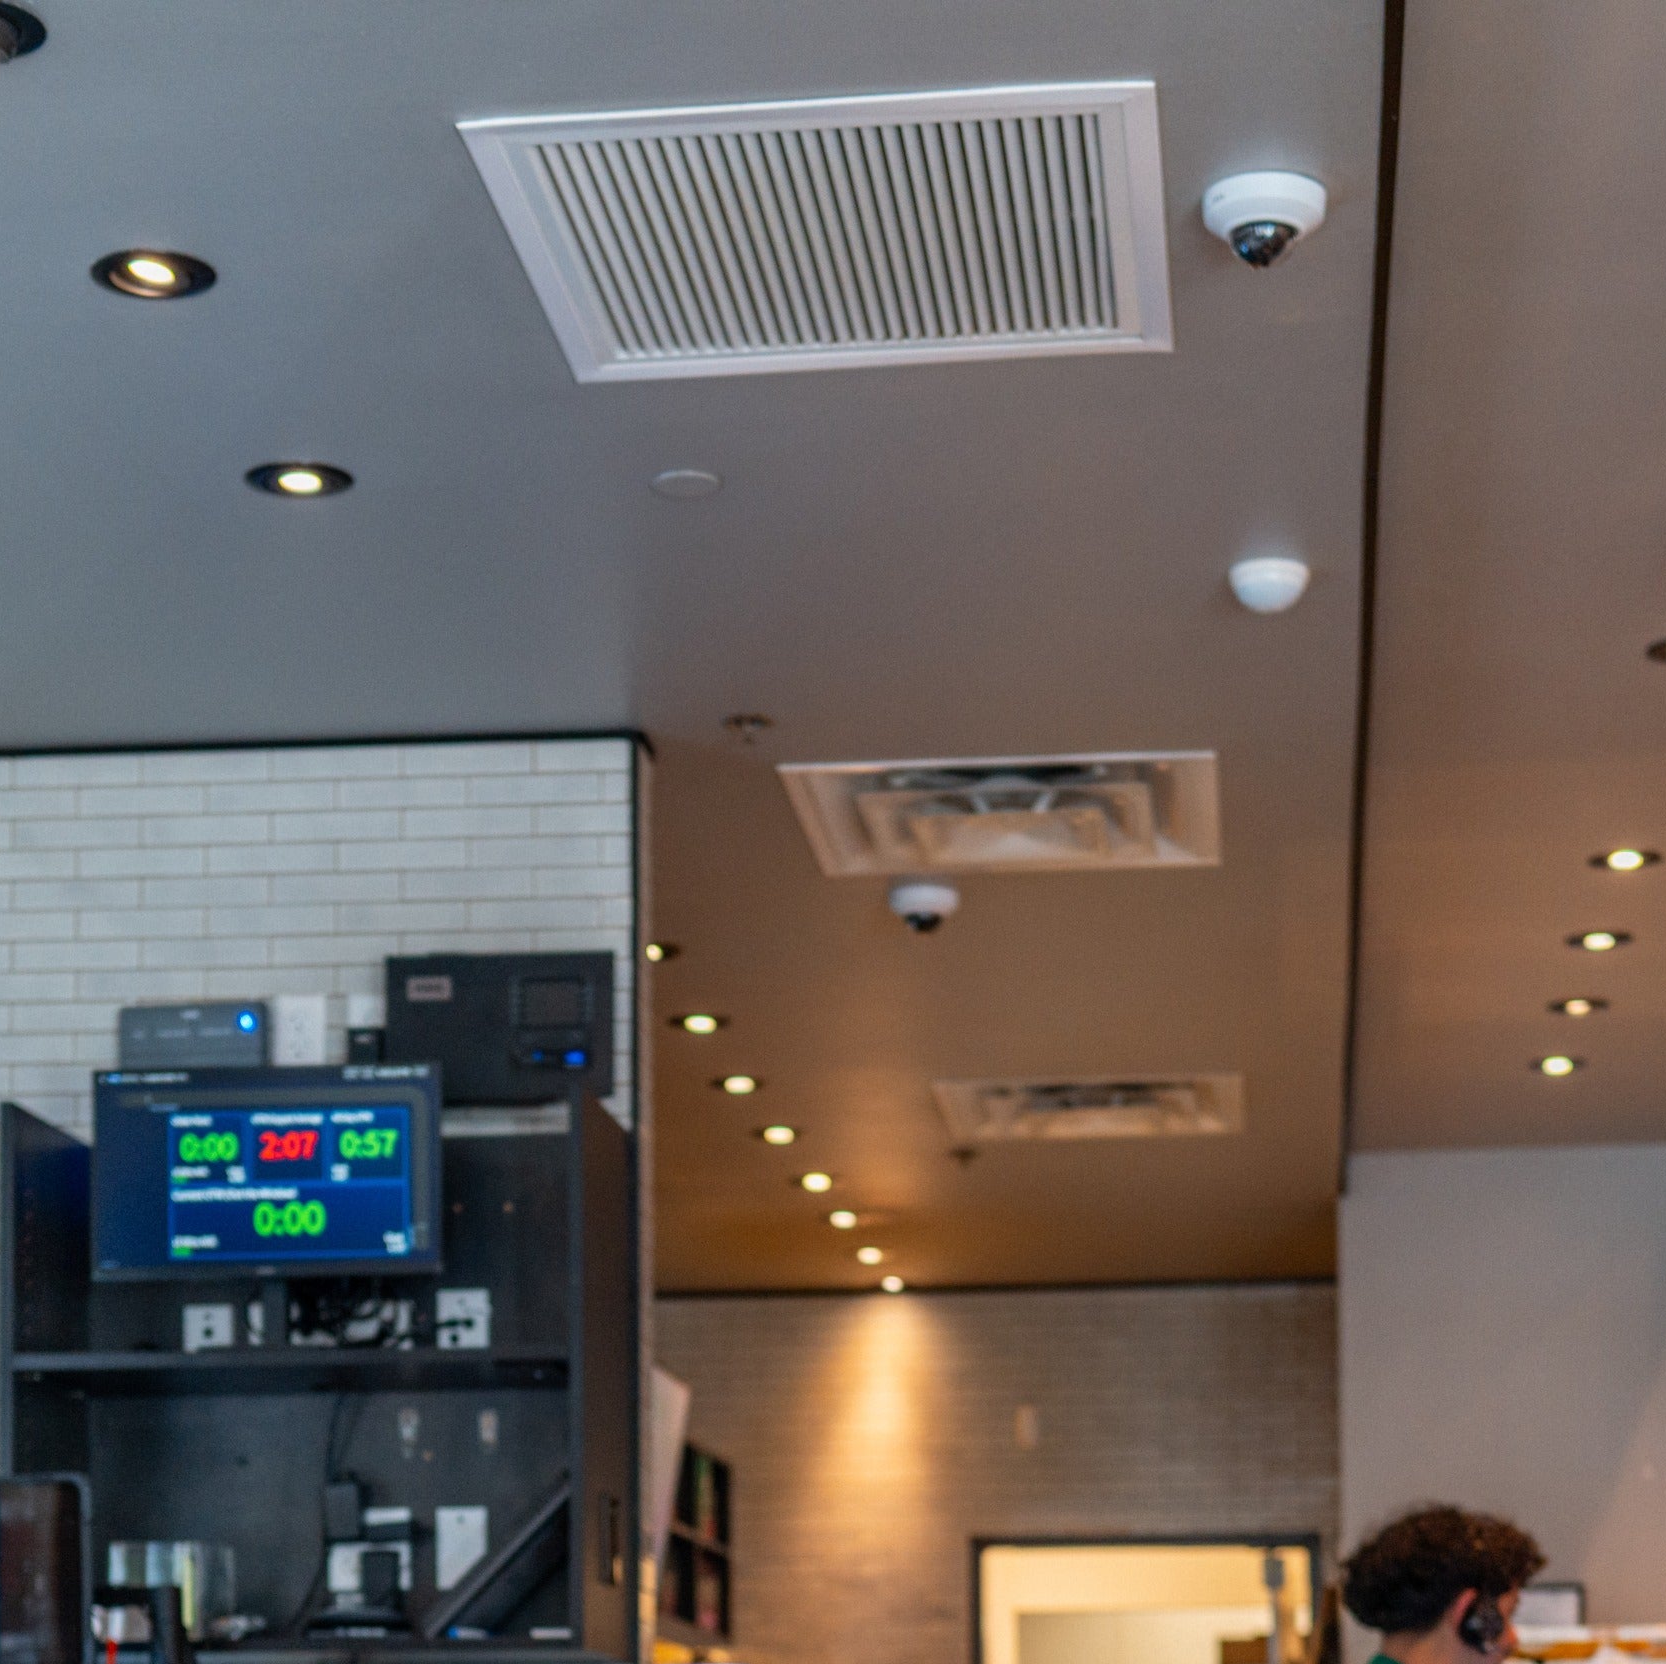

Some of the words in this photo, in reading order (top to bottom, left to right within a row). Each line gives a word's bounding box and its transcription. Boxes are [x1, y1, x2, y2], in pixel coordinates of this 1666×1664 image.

[259, 1130, 319, 1162] 2:07
[339, 1128, 399, 1159] 0:57
[253, 1199, 327, 1237] 0:00
